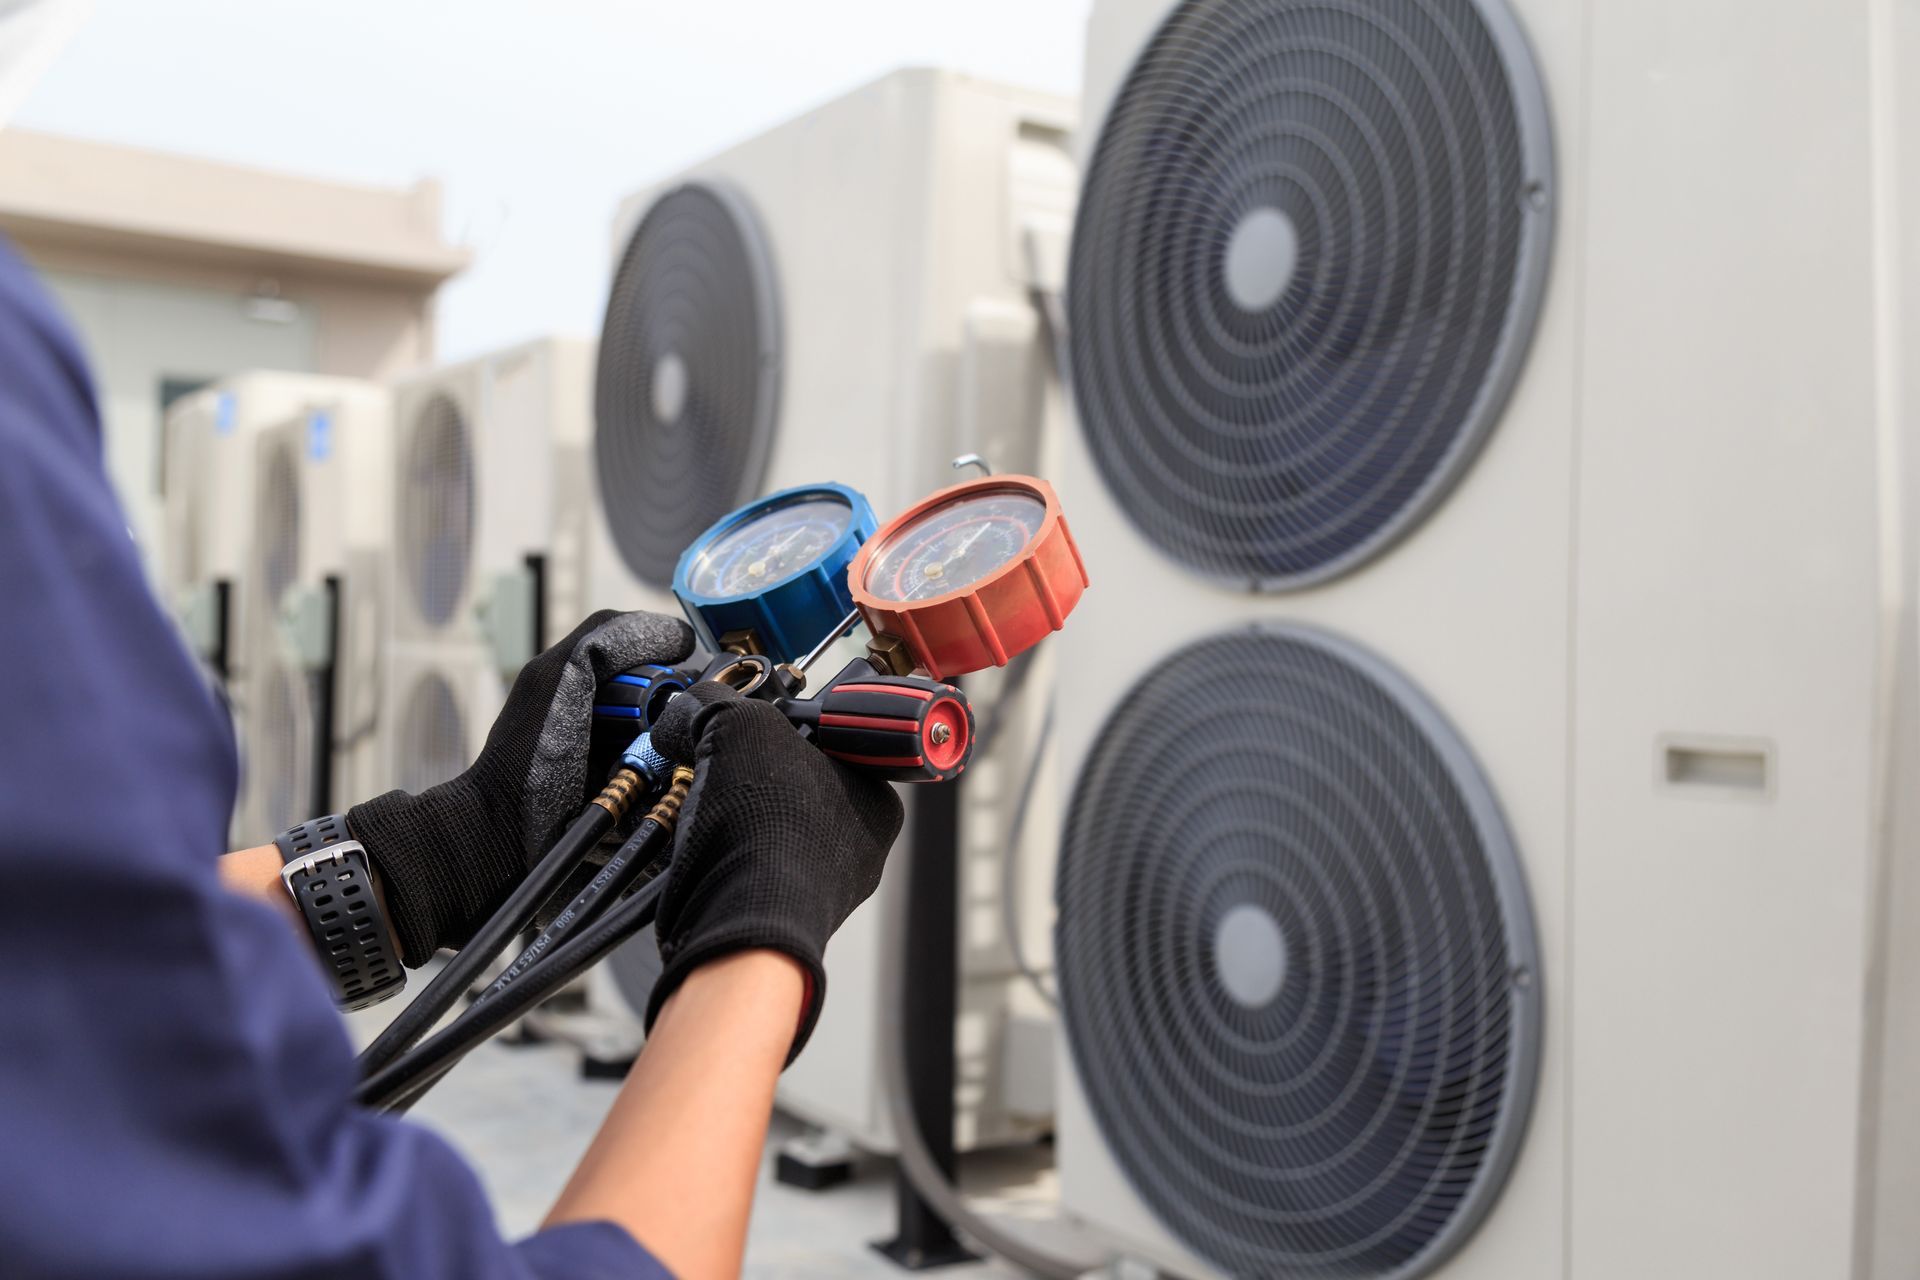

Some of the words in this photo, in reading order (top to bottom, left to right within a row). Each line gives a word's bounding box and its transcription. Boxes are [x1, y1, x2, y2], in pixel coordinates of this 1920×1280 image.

[627, 829, 650, 852] BAR
[591, 857, 626, 894] BURST
[555, 909, 576, 929] 800
[519, 933, 553, 967] PSI/55
[494, 966, 521, 991] BAR
